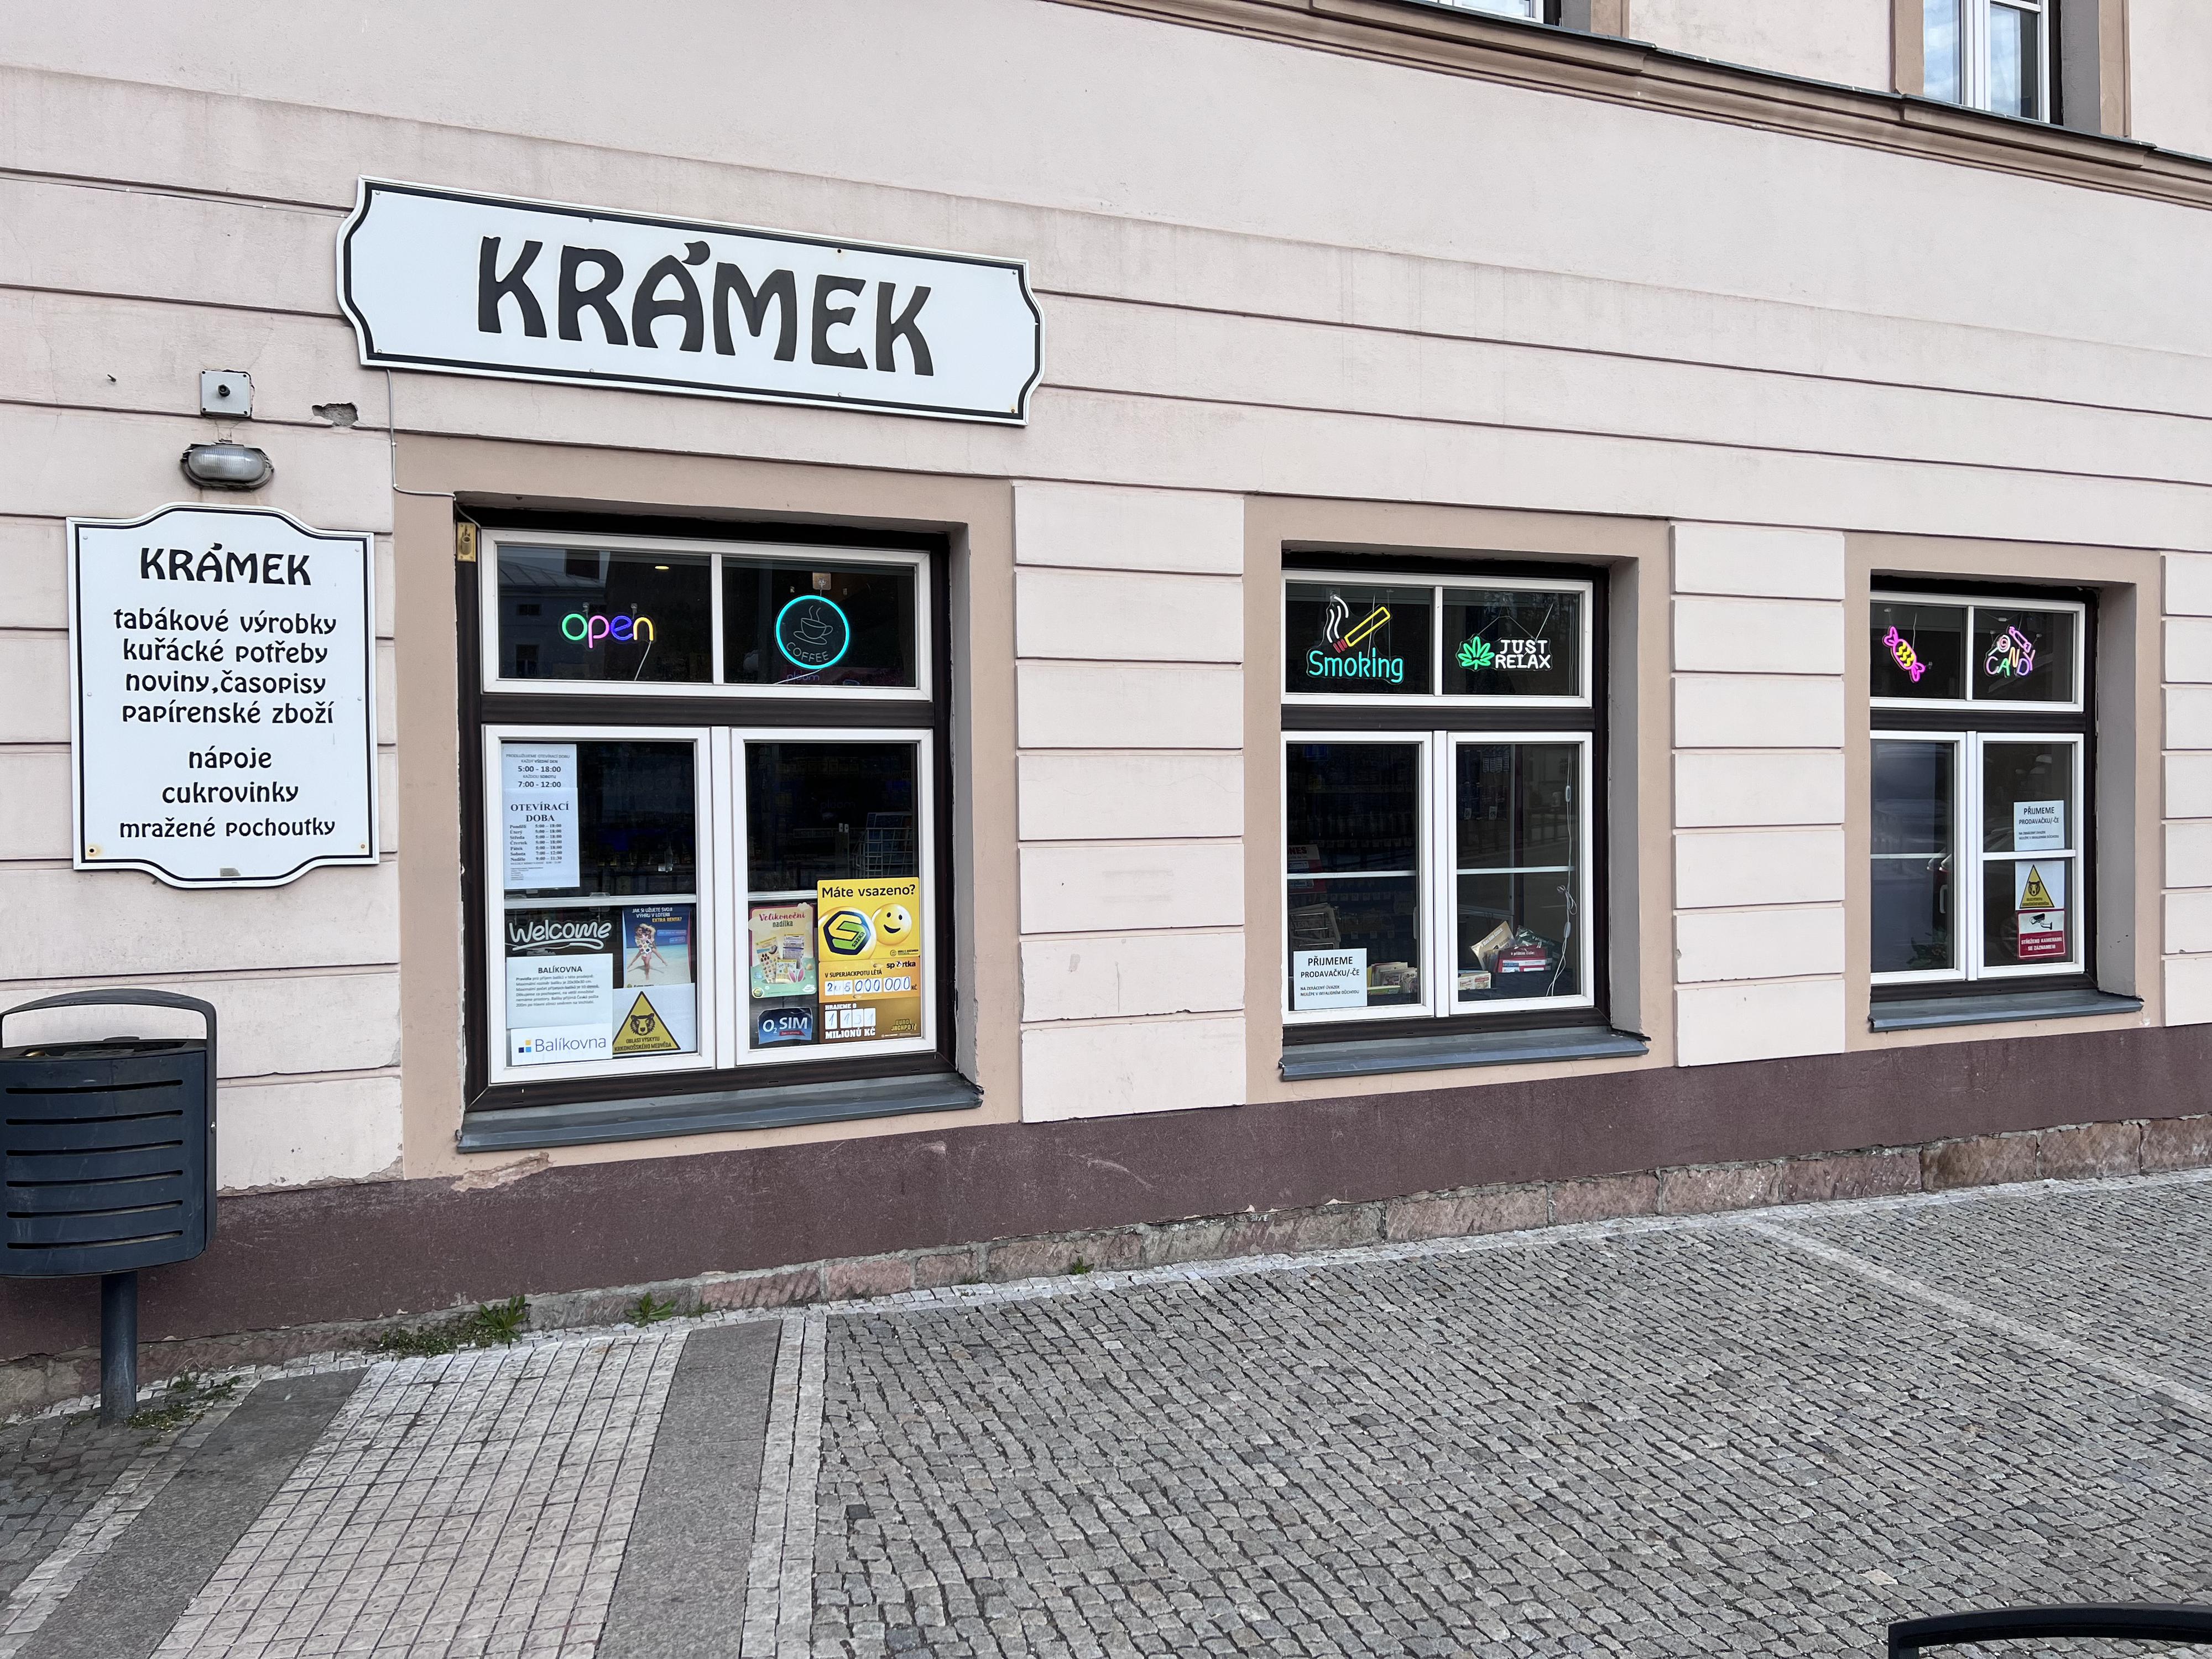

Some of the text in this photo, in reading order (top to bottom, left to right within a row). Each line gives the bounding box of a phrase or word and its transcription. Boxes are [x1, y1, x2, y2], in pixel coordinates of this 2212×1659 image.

[477, 236, 933, 377] KRÁMEK
[140, 542, 312, 586] KRÁMEK
[113, 607, 337, 636] tabákové výrobky
[561, 613, 655, 649] open
[123, 638, 328, 665] kuřácké potřeby
[786, 641, 830, 662] COFFEE
[1500, 639, 1548, 655] JUST
[1308, 646, 1403, 684] Smoking
[1495, 654, 1551, 669] RELAX
[1986, 646, 2036, 677] CANDY
[122, 699, 335, 724] papírenské zboží
[188, 745, 272, 770] nápoje
[161, 781, 299, 804] cukrovinky
[510, 801, 569, 811] OTEVÍRACÍ
[2023, 806, 2054, 815] PŘIJMEME
[120, 817, 336, 838] mražené pochoutky
[822, 884, 916, 899] Máte vsazeno?
[759, 912, 805, 922] Velikonoční
[509, 919, 612, 943] Welcome
[852, 931, 865, 948] sazka
[1308, 956, 1353, 966] PŘIJMEME
[1301, 968, 1360, 978] PRODAVAČKU/-ČE
[779, 1017, 807, 1030] SIM
[825, 1027, 862, 1040] MILIONŮ
[535, 1037, 607, 1052] Balíkovna
